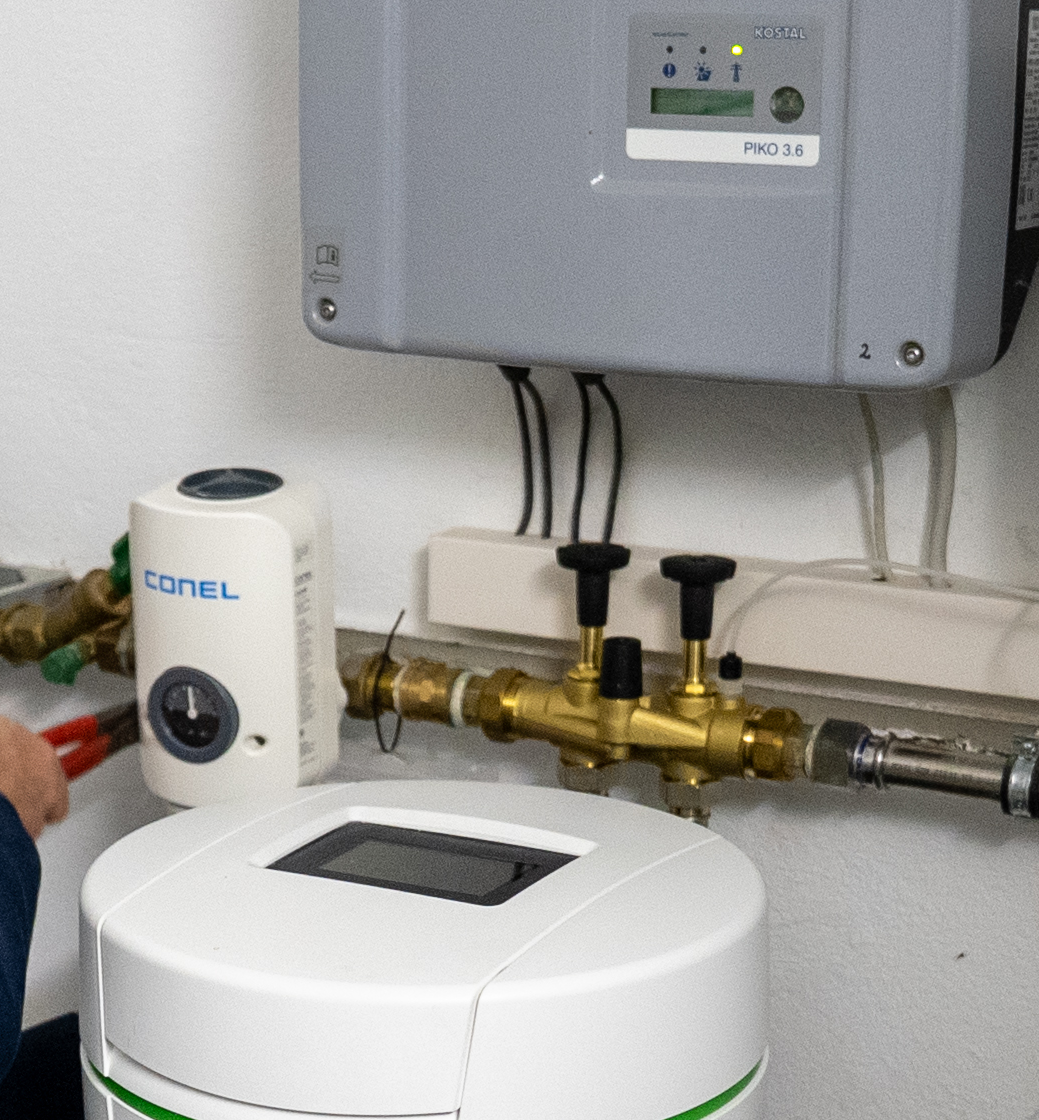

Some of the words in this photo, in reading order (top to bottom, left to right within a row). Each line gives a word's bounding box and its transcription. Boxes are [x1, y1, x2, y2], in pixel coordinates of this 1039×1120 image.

[754, 26, 807, 40] KOSTAL
[743, 142, 779, 157] PIKO
[782, 144, 804, 157] 3.6
[859, 343, 871, 359] 2
[144, 569, 239, 600] CONEL
